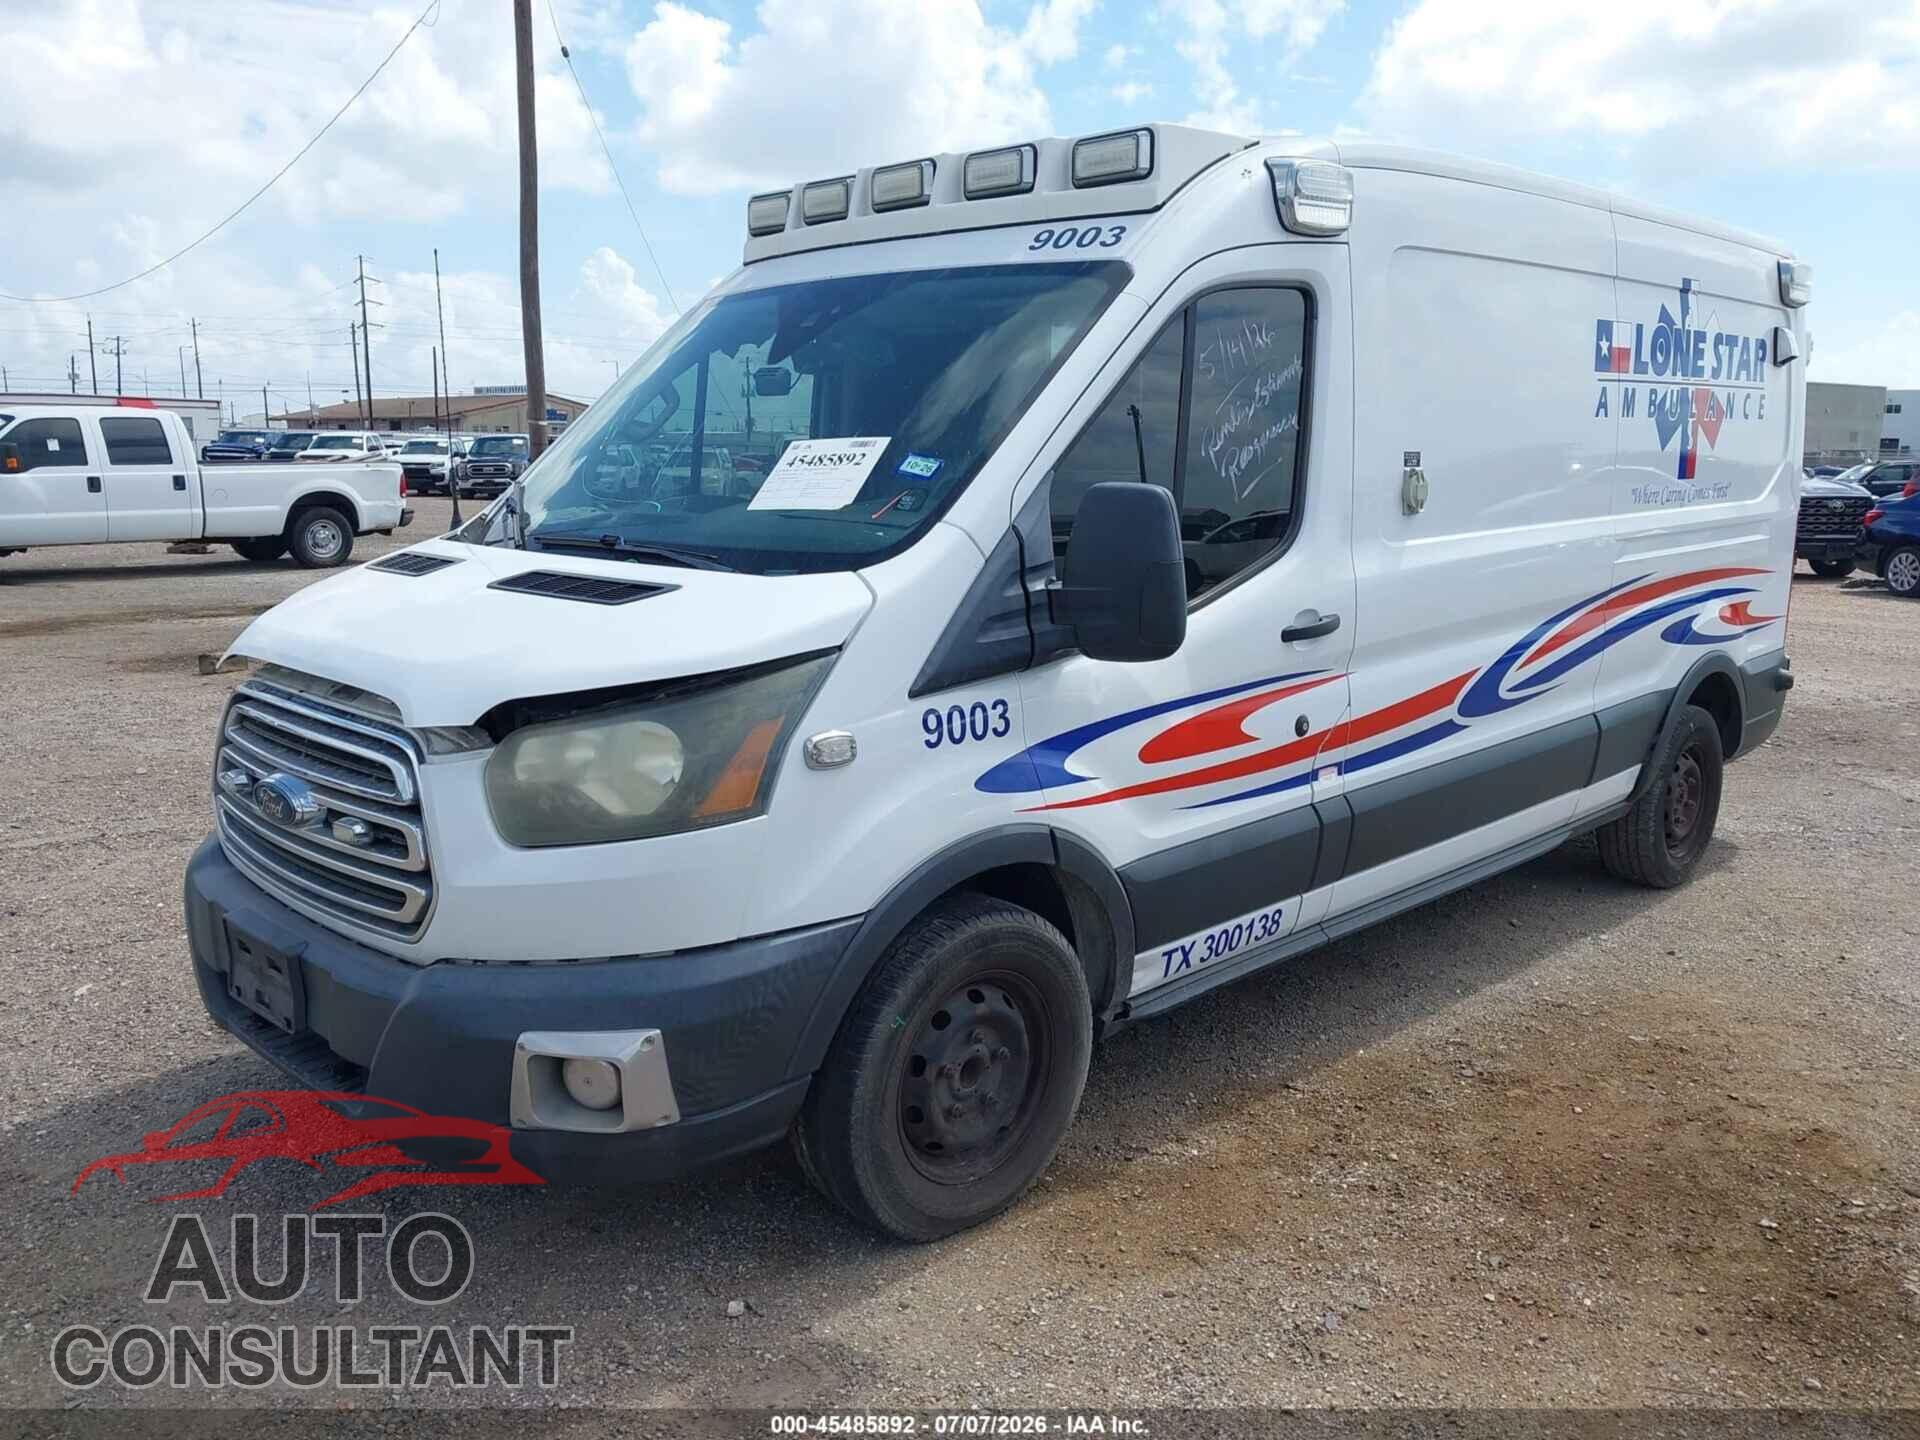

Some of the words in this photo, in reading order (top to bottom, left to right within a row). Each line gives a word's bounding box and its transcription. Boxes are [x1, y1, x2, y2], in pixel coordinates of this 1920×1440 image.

[1028, 225, 1127, 251] 9003
[1633, 322, 1707, 379] LONE
[1711, 332, 1768, 383] STAR
[1594, 386, 1767, 421] AMBULANCE
[786, 452, 867, 468] 45485892
[922, 698, 1011, 749] 9003
[1161, 940, 1197, 978] TX
[1200, 908, 1283, 964] 300138
